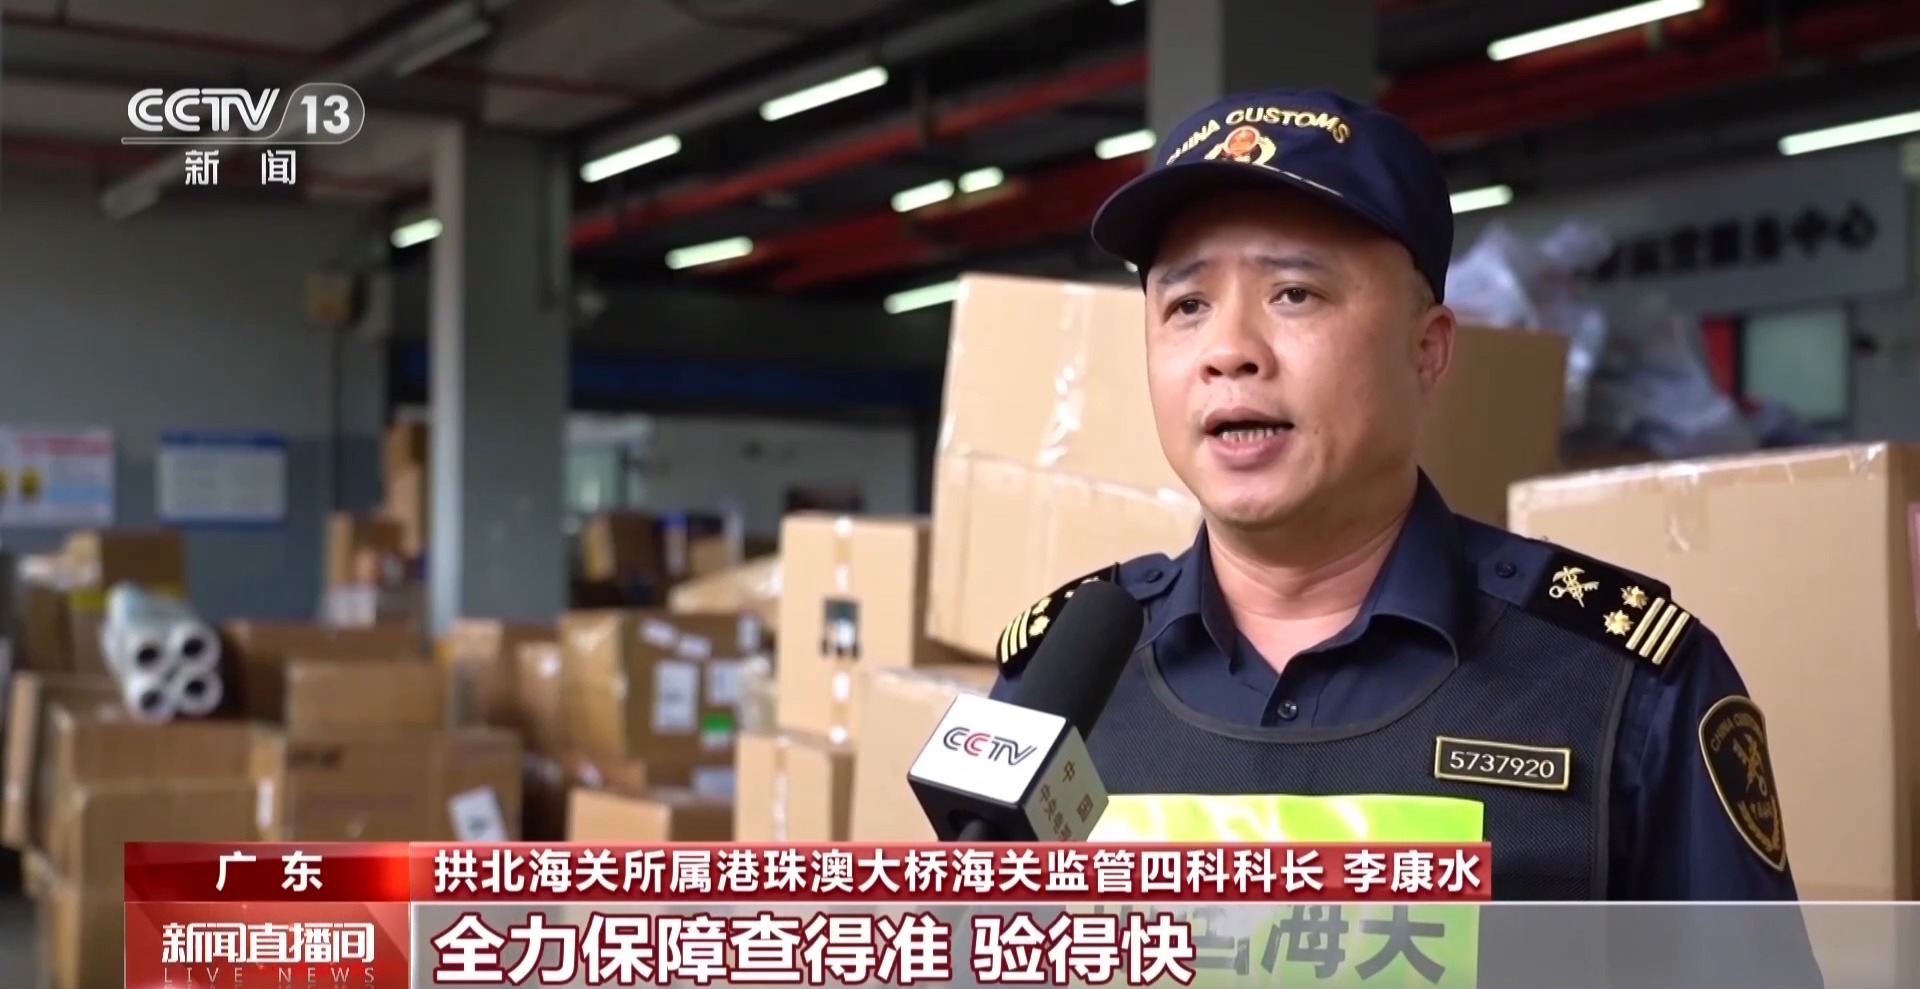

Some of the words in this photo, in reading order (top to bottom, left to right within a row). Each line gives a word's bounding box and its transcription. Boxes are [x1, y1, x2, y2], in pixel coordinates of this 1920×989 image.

[1225, 107, 1350, 144] CUSTOMS
[943, 727, 1038, 766] CCTV
[1449, 750, 1555, 779] 5737920
